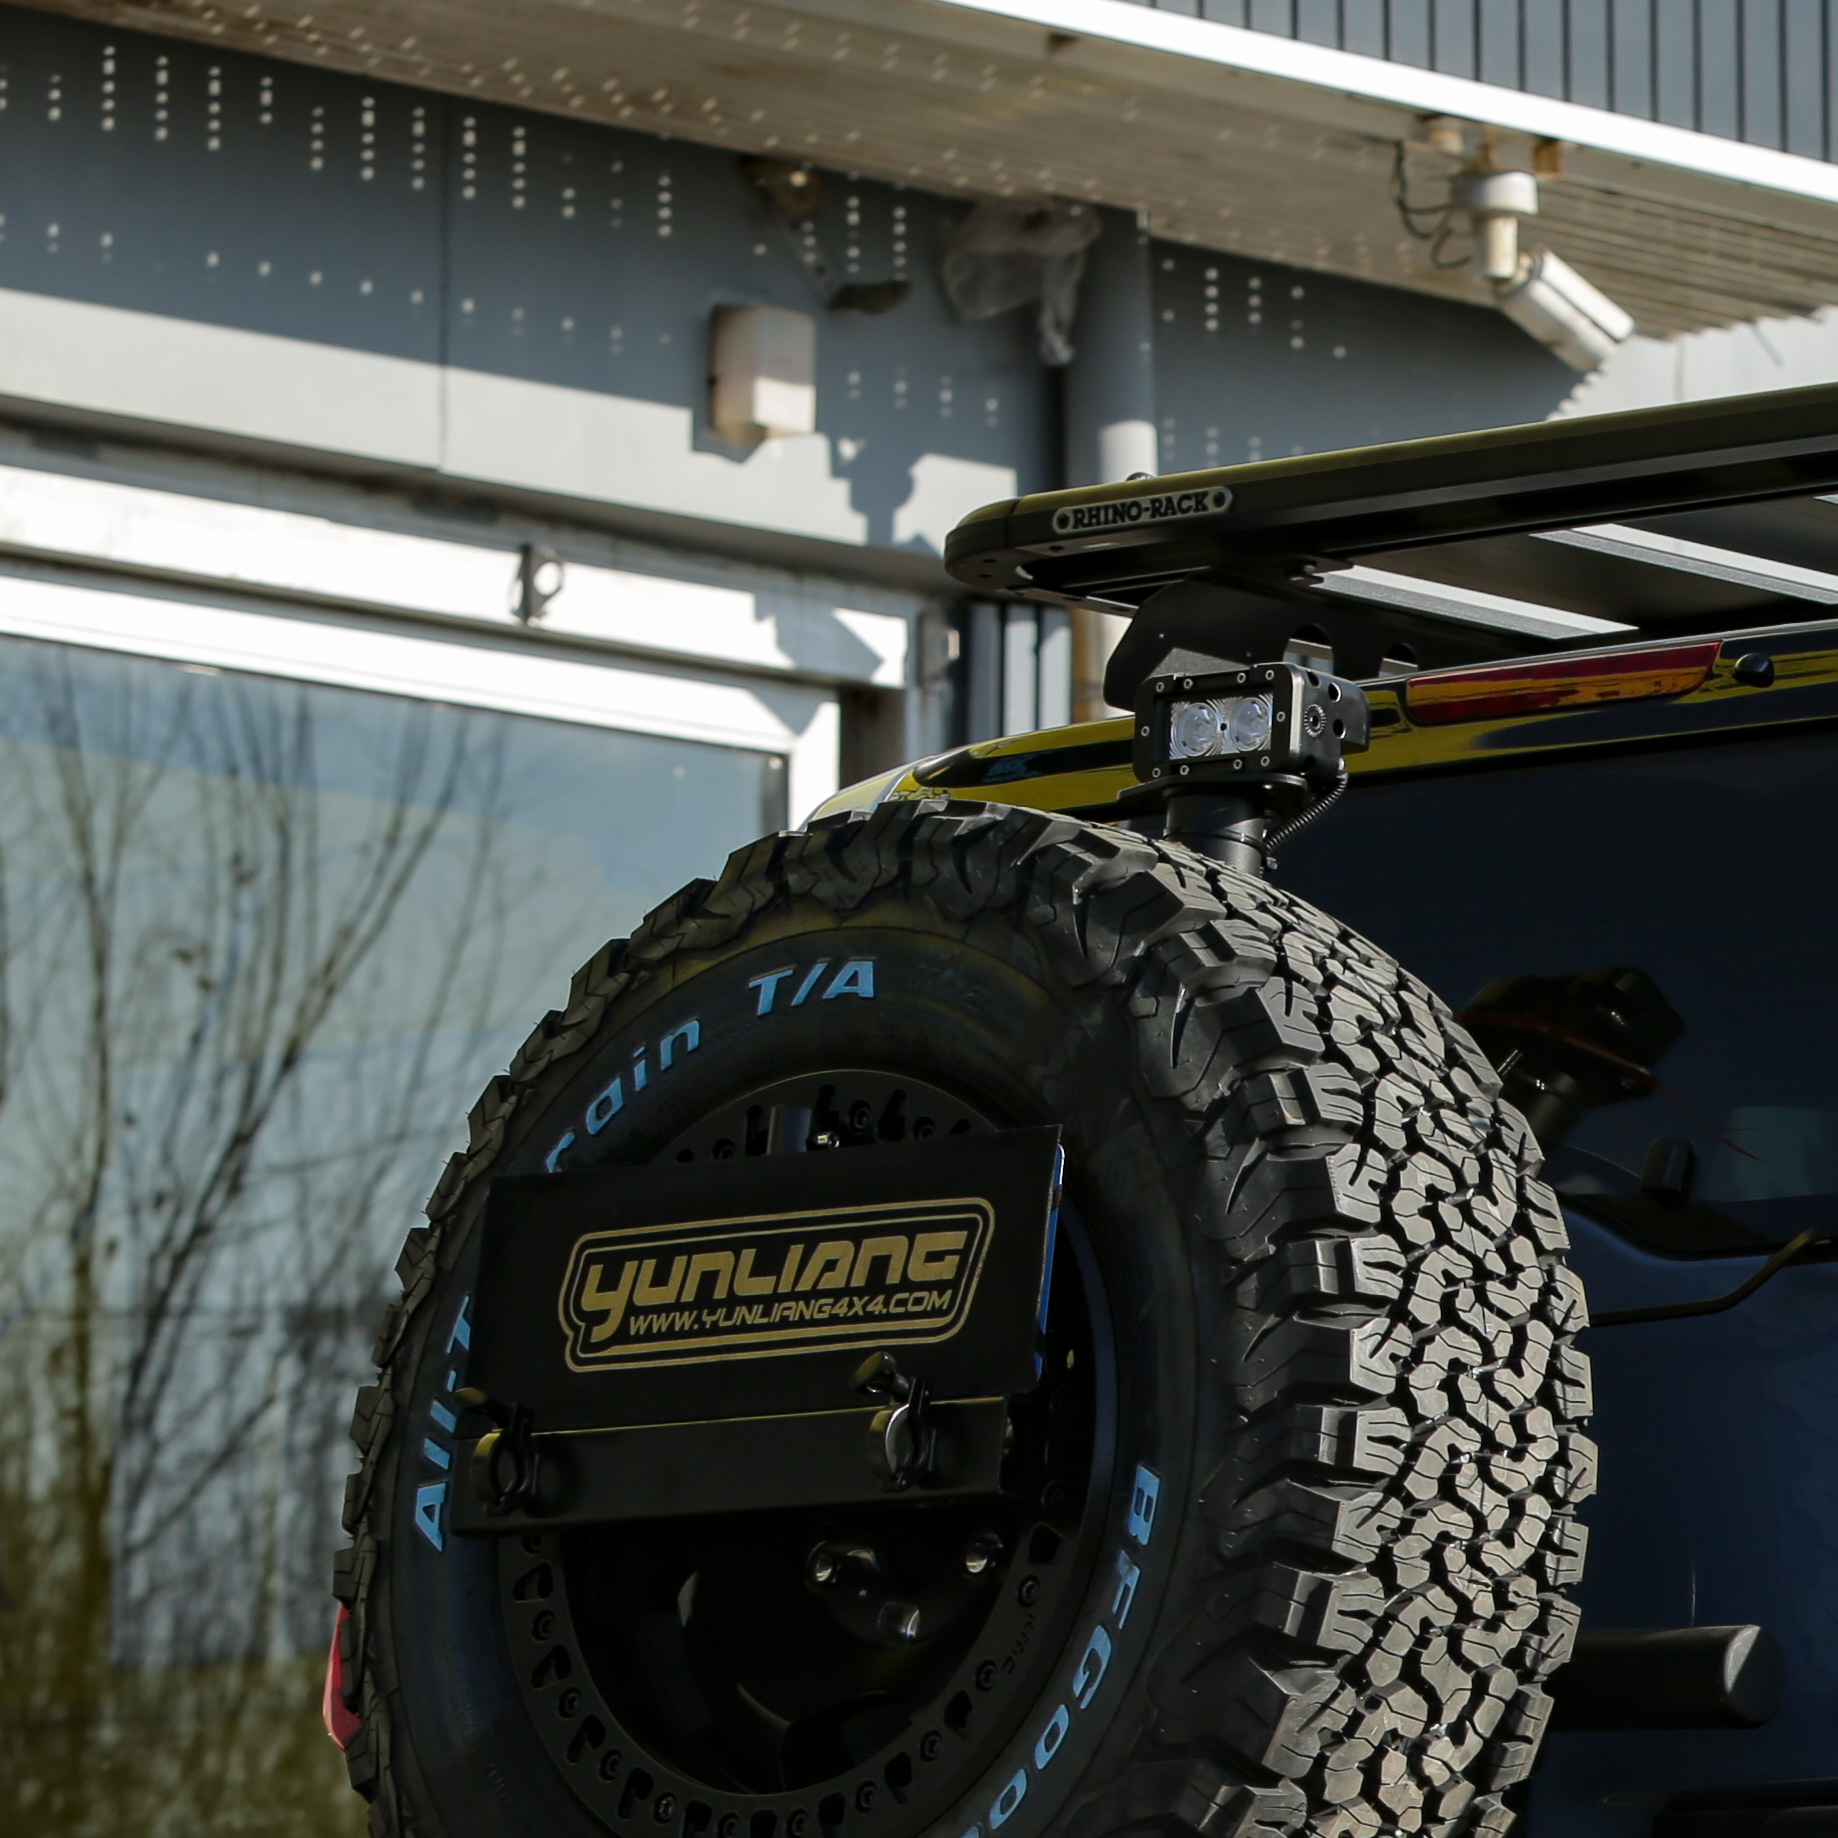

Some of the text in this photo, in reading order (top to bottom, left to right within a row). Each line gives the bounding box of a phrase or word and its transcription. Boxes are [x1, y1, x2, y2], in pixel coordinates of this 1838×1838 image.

[1071, 491, 1210, 530] RHINO-RACK
[748, 960, 875, 1016] T/A
[580, 1231, 968, 1342] YUNLIANG
[629, 1290, 953, 1336] WWW.YUNLIANG4X4.COM
